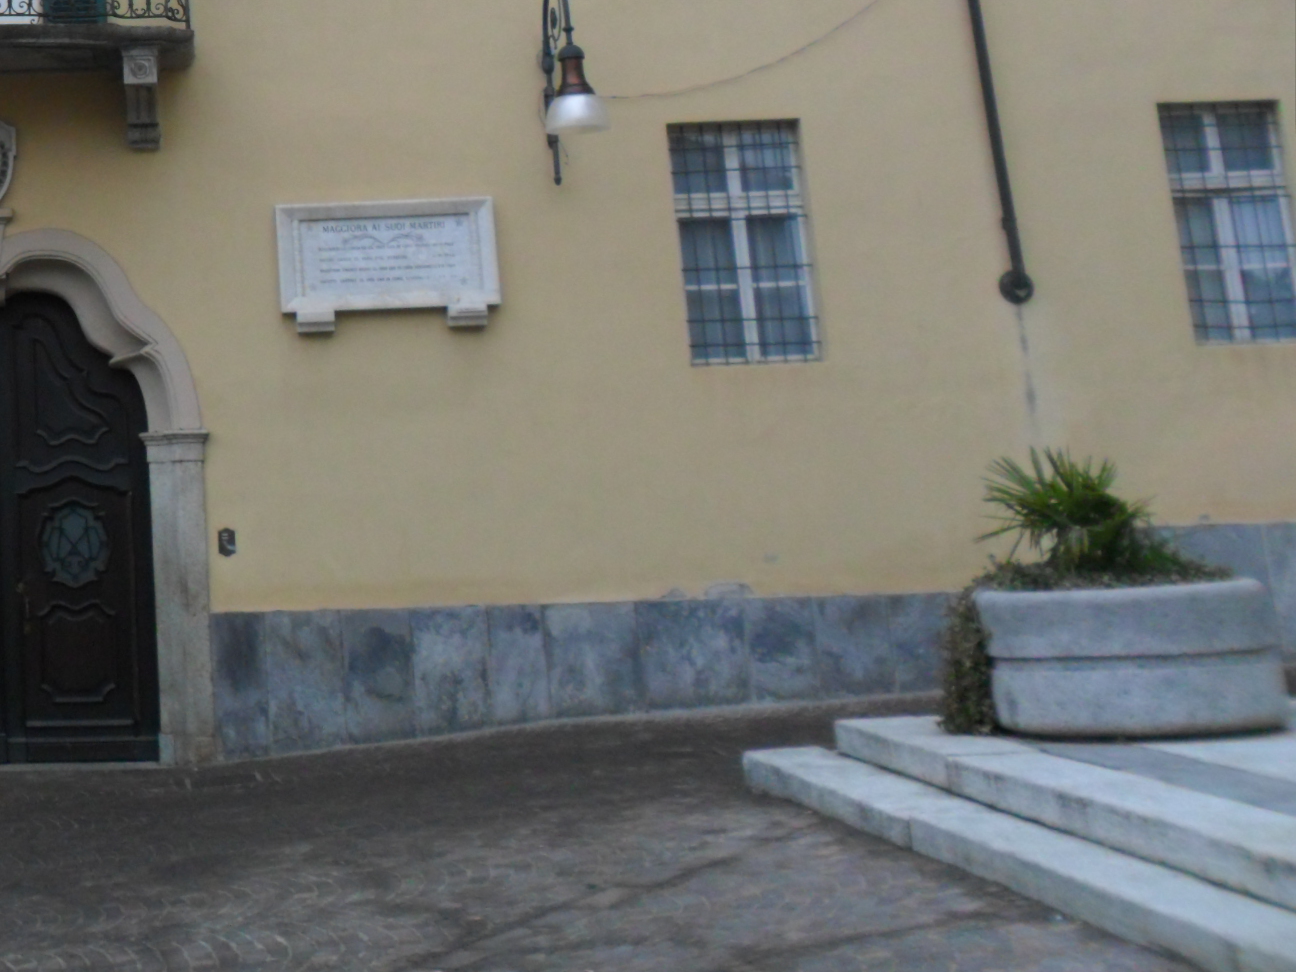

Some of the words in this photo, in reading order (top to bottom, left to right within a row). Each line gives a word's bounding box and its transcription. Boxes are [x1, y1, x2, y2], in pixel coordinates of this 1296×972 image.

[322, 223, 368, 233] MAGGIORA
[371, 223, 381, 232] AI
[385, 222, 406, 231] SUOI
[409, 220, 446, 230] MARTIRI
